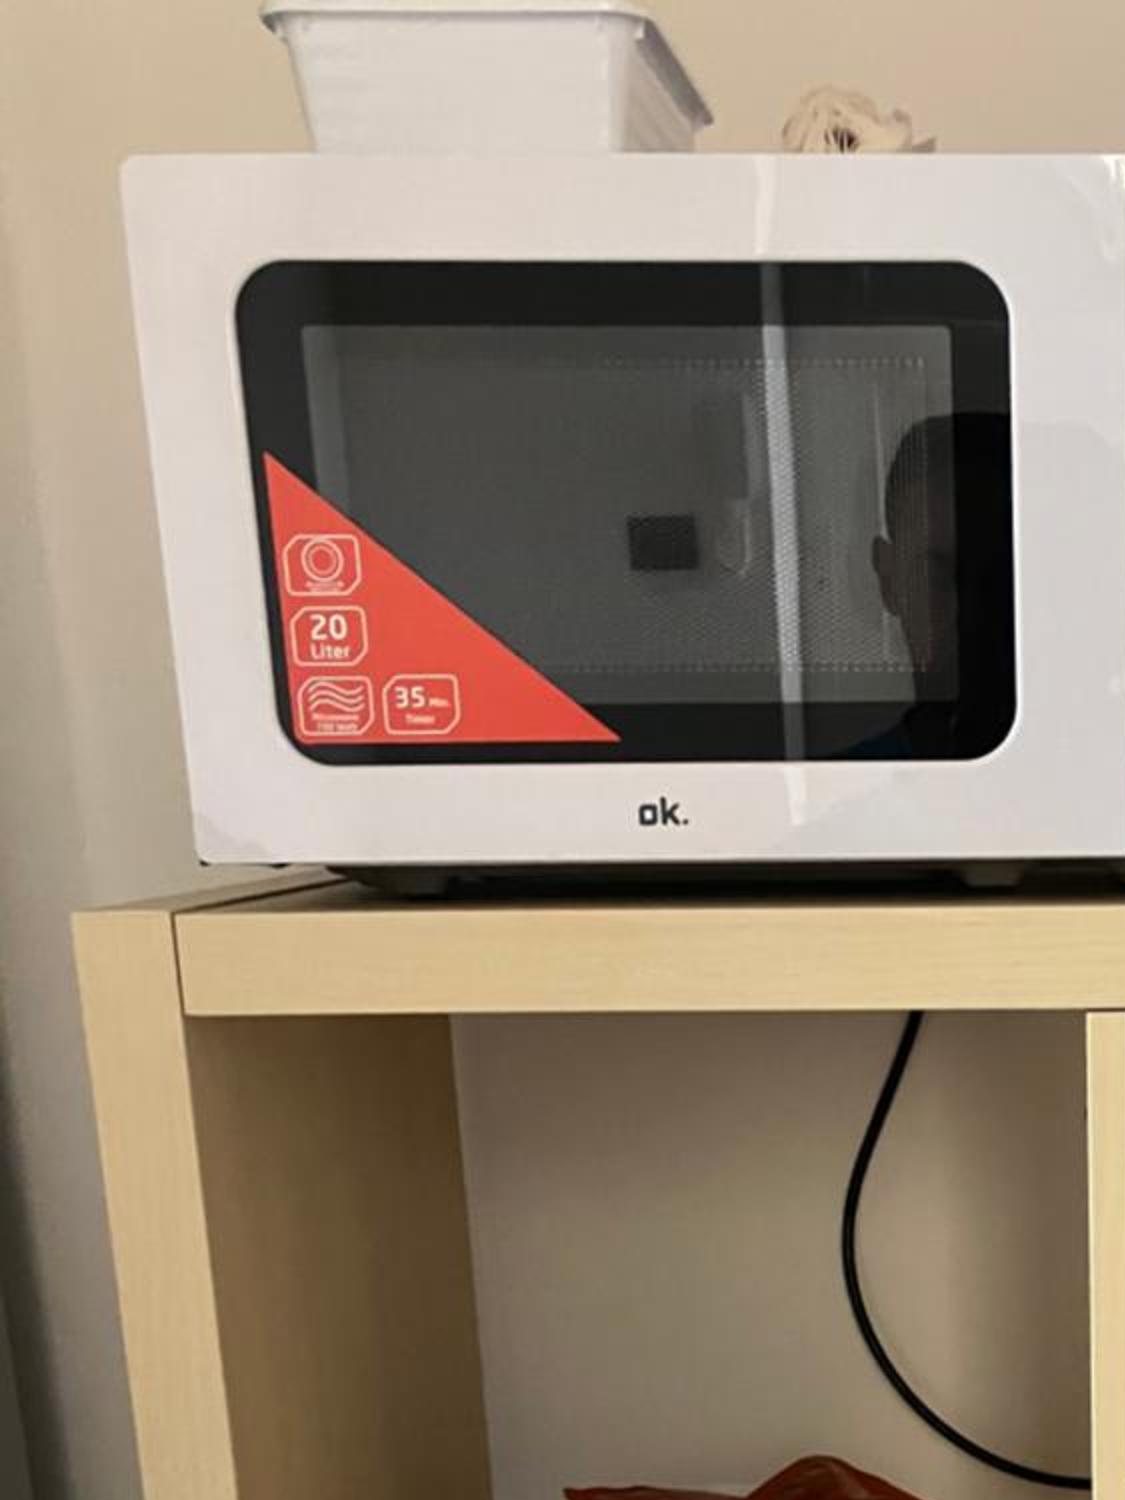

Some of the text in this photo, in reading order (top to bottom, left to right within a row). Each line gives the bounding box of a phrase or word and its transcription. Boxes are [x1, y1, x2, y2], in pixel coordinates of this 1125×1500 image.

[310, 613, 348, 641] 20
[309, 644, 351, 660] Liter
[394, 685, 426, 709] 35
